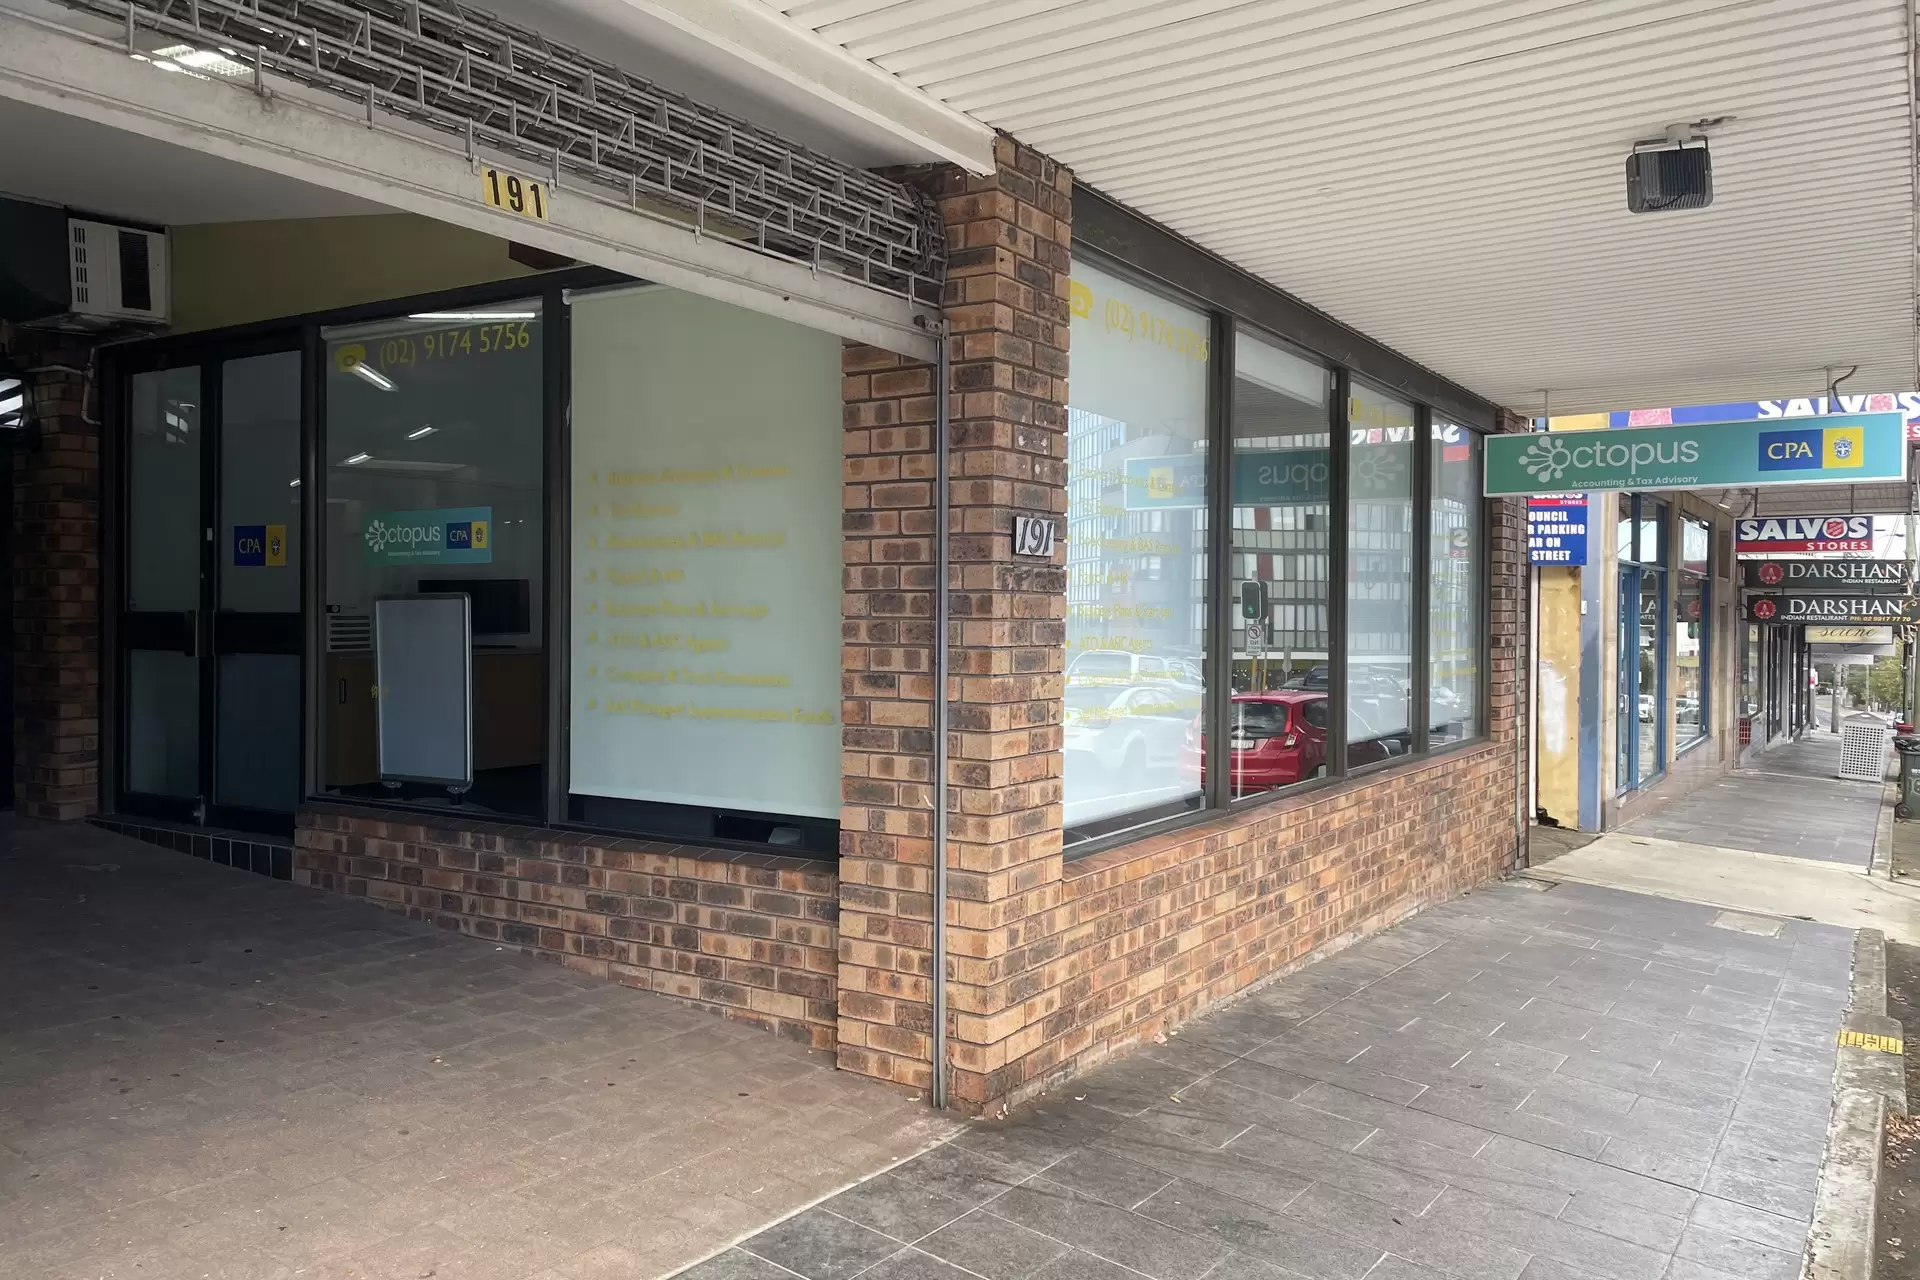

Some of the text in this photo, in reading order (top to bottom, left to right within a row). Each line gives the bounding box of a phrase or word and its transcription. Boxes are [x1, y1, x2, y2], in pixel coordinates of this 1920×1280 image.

[488, 170, 542, 218] 191
[1104, 296, 1134, 342] (02)
[1140, 312, 1173, 348] 9174
[380, 323, 530, 373] (02) 9174 5756
[1767, 441, 1813, 460] CPA
[1572, 475, 1698, 488] Accounting & Tax Advisory
[1528, 511, 1568, 521] OUNCIL
[449, 530, 468, 541] CPA
[1018, 518, 1053, 555] 191
[1538, 524, 1585, 535] PARKING
[1740, 517, 1868, 541] SALVOS
[238, 538, 261, 554] CPA
[1546, 537, 1560, 547] ON
[1806, 541, 1868, 551] STORES
[1531, 550, 1571, 561] STREET
[1788, 563, 1902, 579] DARSHAN
[1789, 599, 1903, 615] DARSHAN
